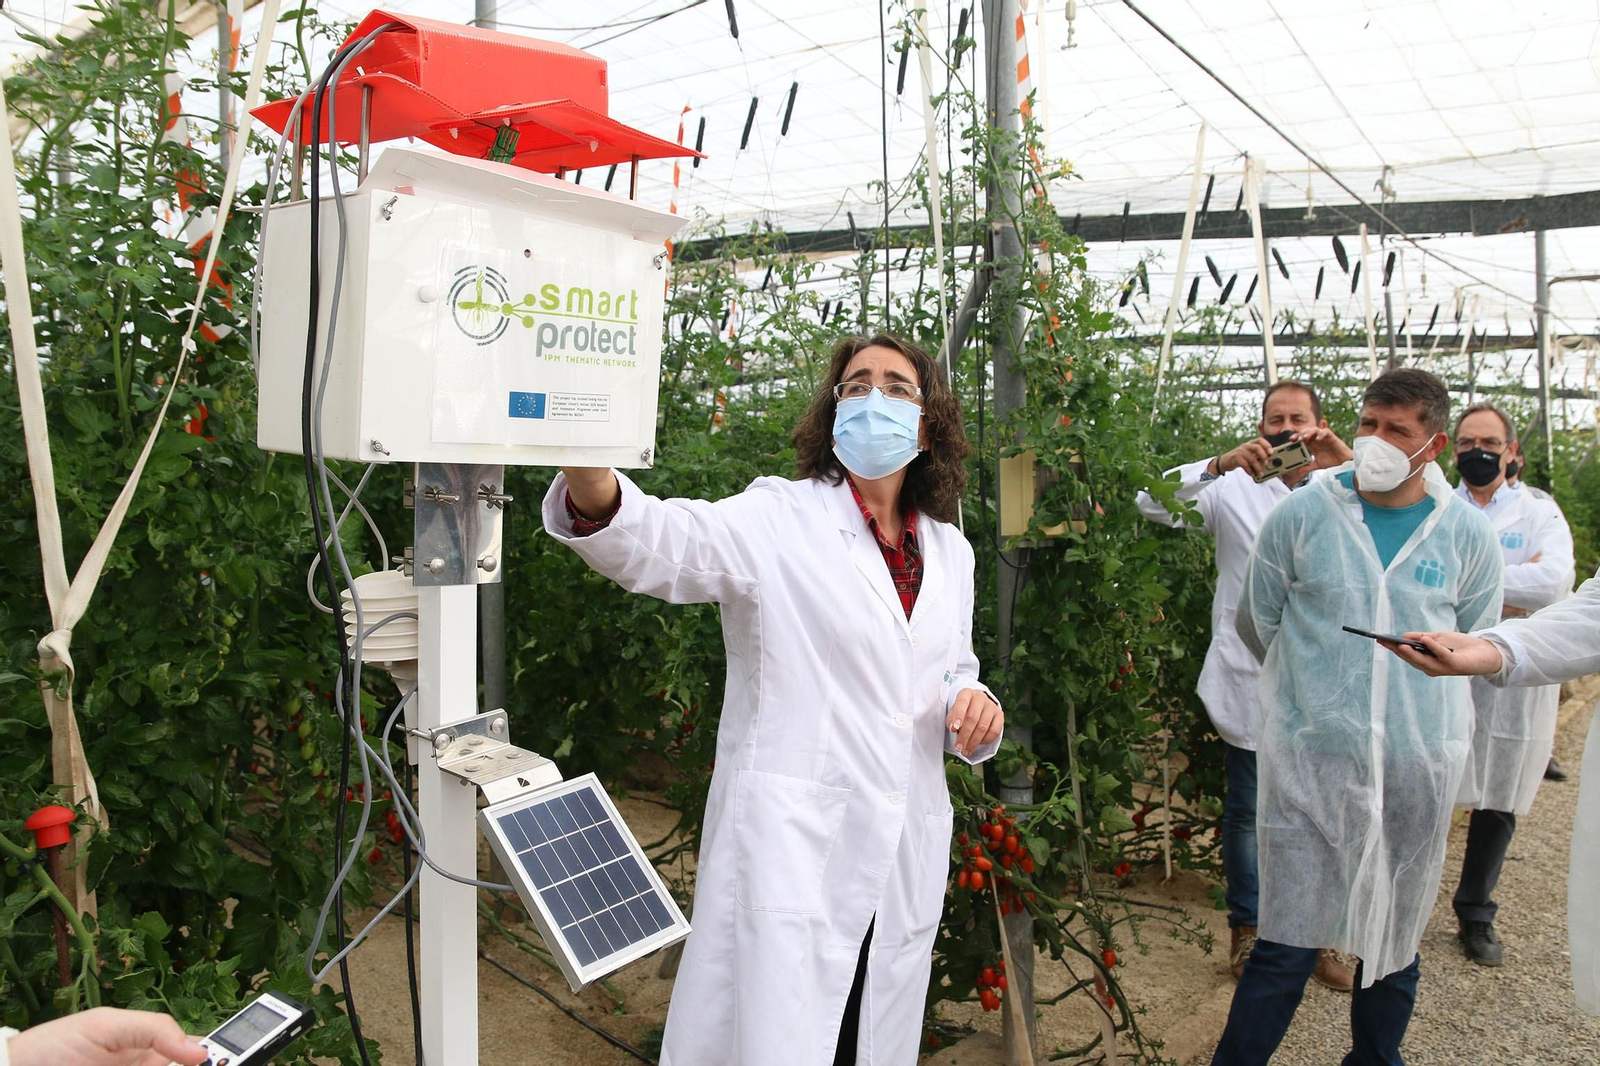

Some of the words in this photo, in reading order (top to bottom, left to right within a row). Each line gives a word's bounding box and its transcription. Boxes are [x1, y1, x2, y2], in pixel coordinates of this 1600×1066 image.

[539, 283, 639, 320] smart
[535, 321, 637, 358] protect
[544, 354, 561, 363] IPM
[565, 355, 601, 366] THEMATIC
[603, 358, 637, 368] NETWORK
